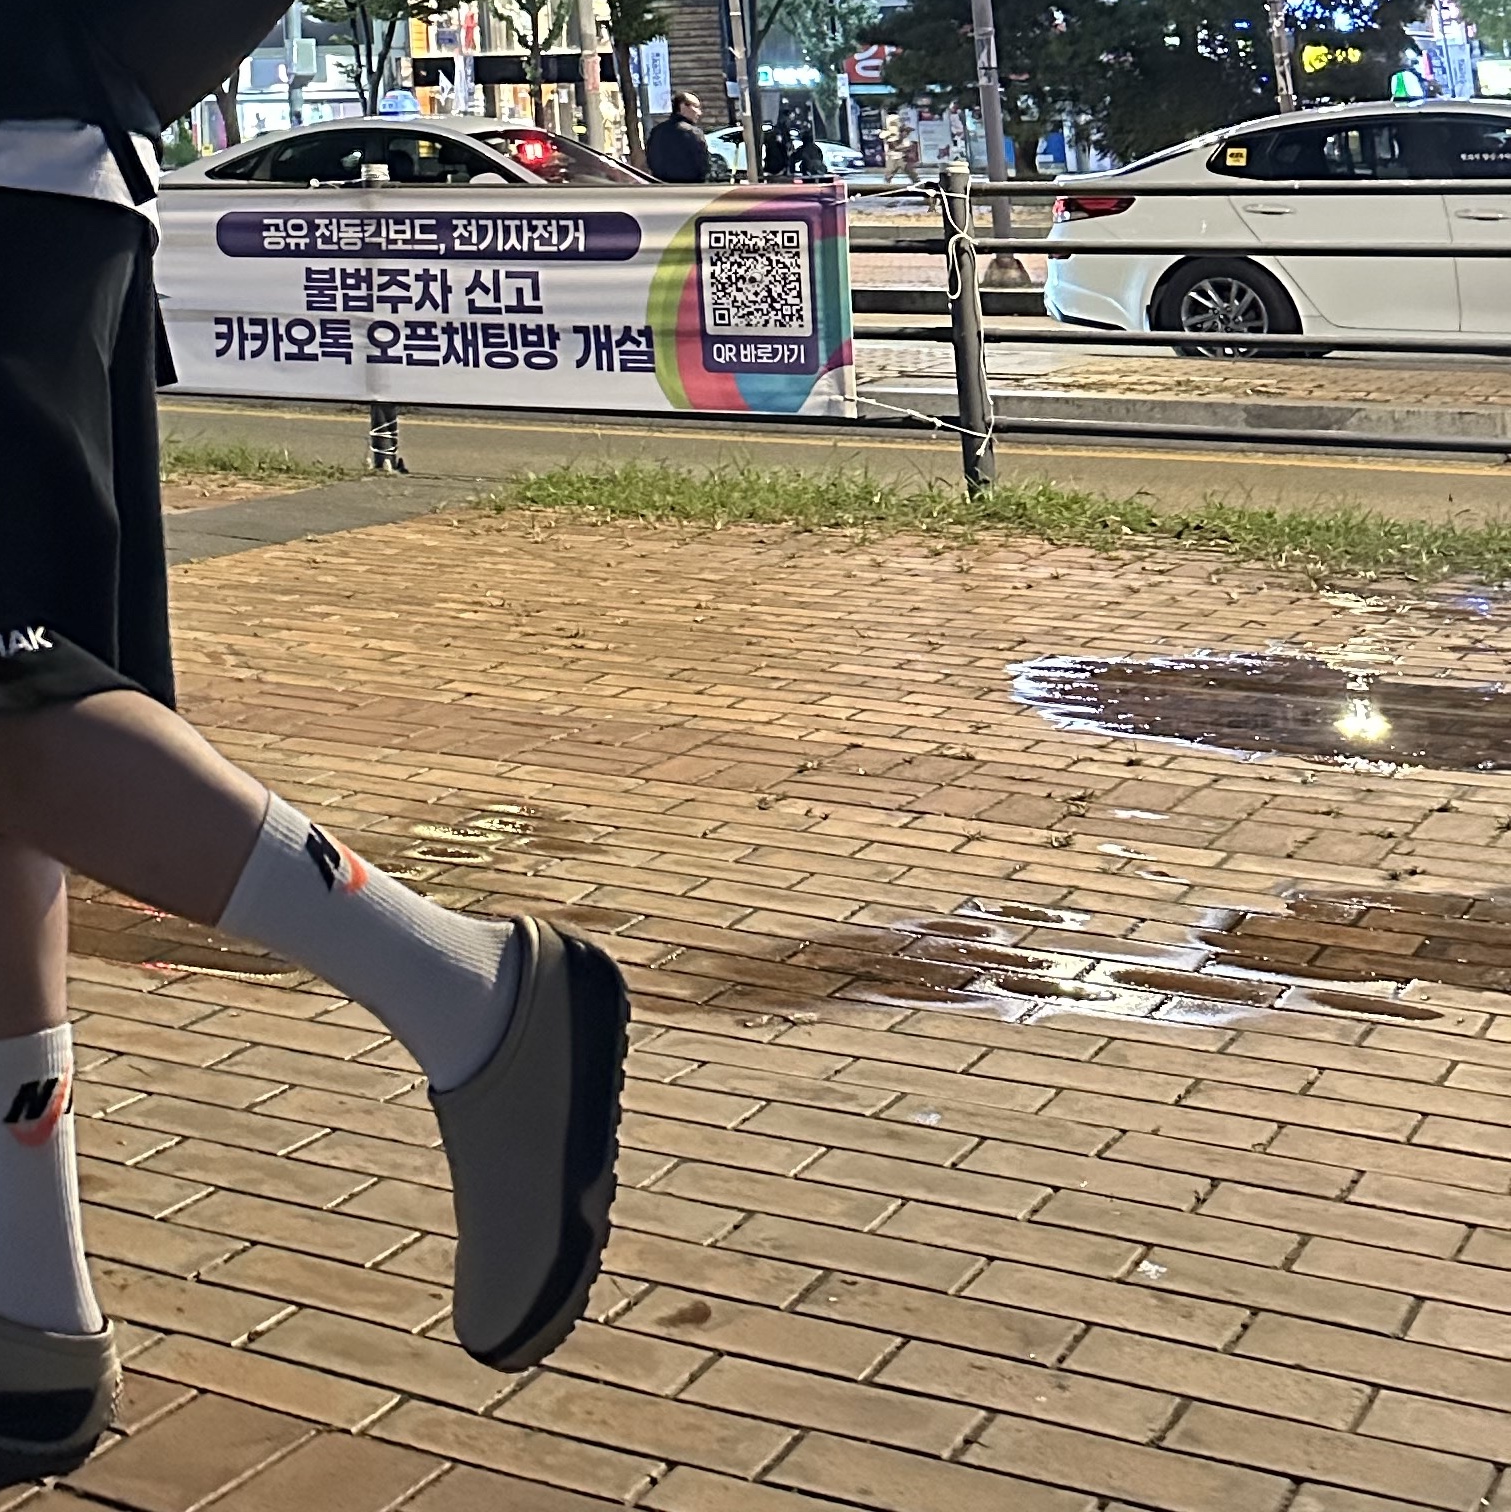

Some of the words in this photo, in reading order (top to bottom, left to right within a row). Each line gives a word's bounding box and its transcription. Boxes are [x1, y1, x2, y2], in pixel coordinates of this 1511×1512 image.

[262, 218, 310, 251] 공유
[314, 218, 447, 256] 전동킥보드,
[452, 218, 586, 253] 전기자전거
[303, 266, 453, 315] 불법주차
[464, 268, 544, 316] 신고
[213, 316, 354, 365] 카카오톡
[366, 320, 561, 371] 오픈채팅방
[572, 324, 656, 374] 개설
[712, 343, 738, 364] QR
[740, 343, 806, 365] 바로가기
